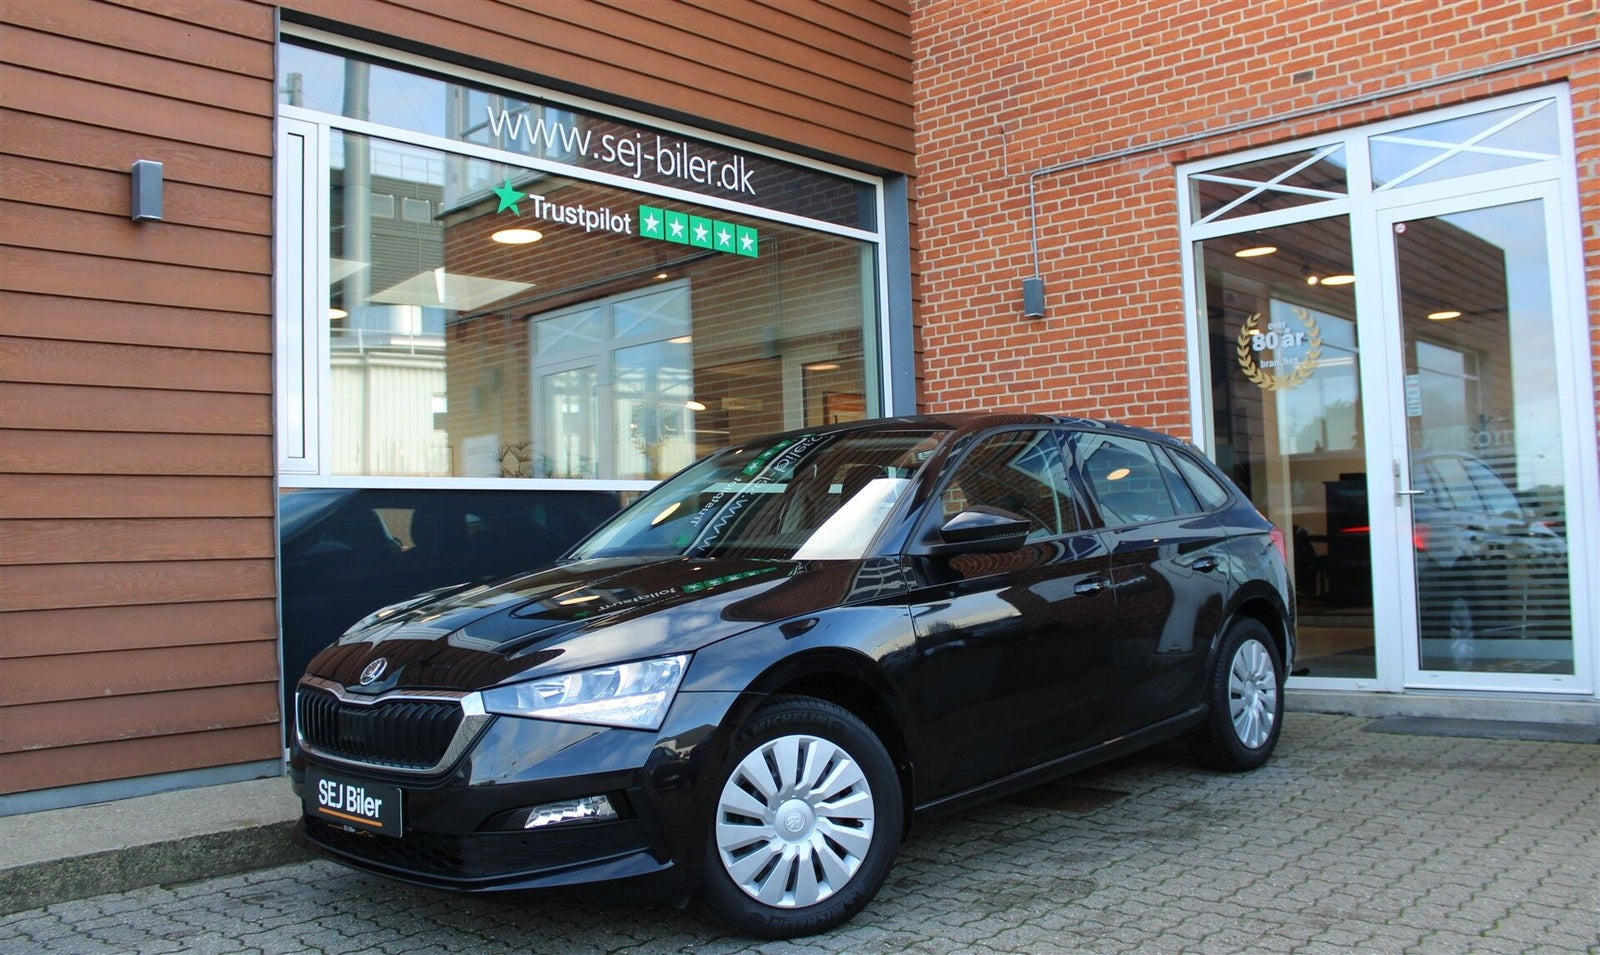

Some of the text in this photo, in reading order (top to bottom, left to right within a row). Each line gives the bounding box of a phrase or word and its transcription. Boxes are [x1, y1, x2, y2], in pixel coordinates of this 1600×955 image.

[487, 106, 756, 195] www.sej-biler.dk
[529, 193, 632, 235] Trustpilot
[1252, 327, 1304, 352] 80 år
[318, 779, 383, 818] SEJ Biler
